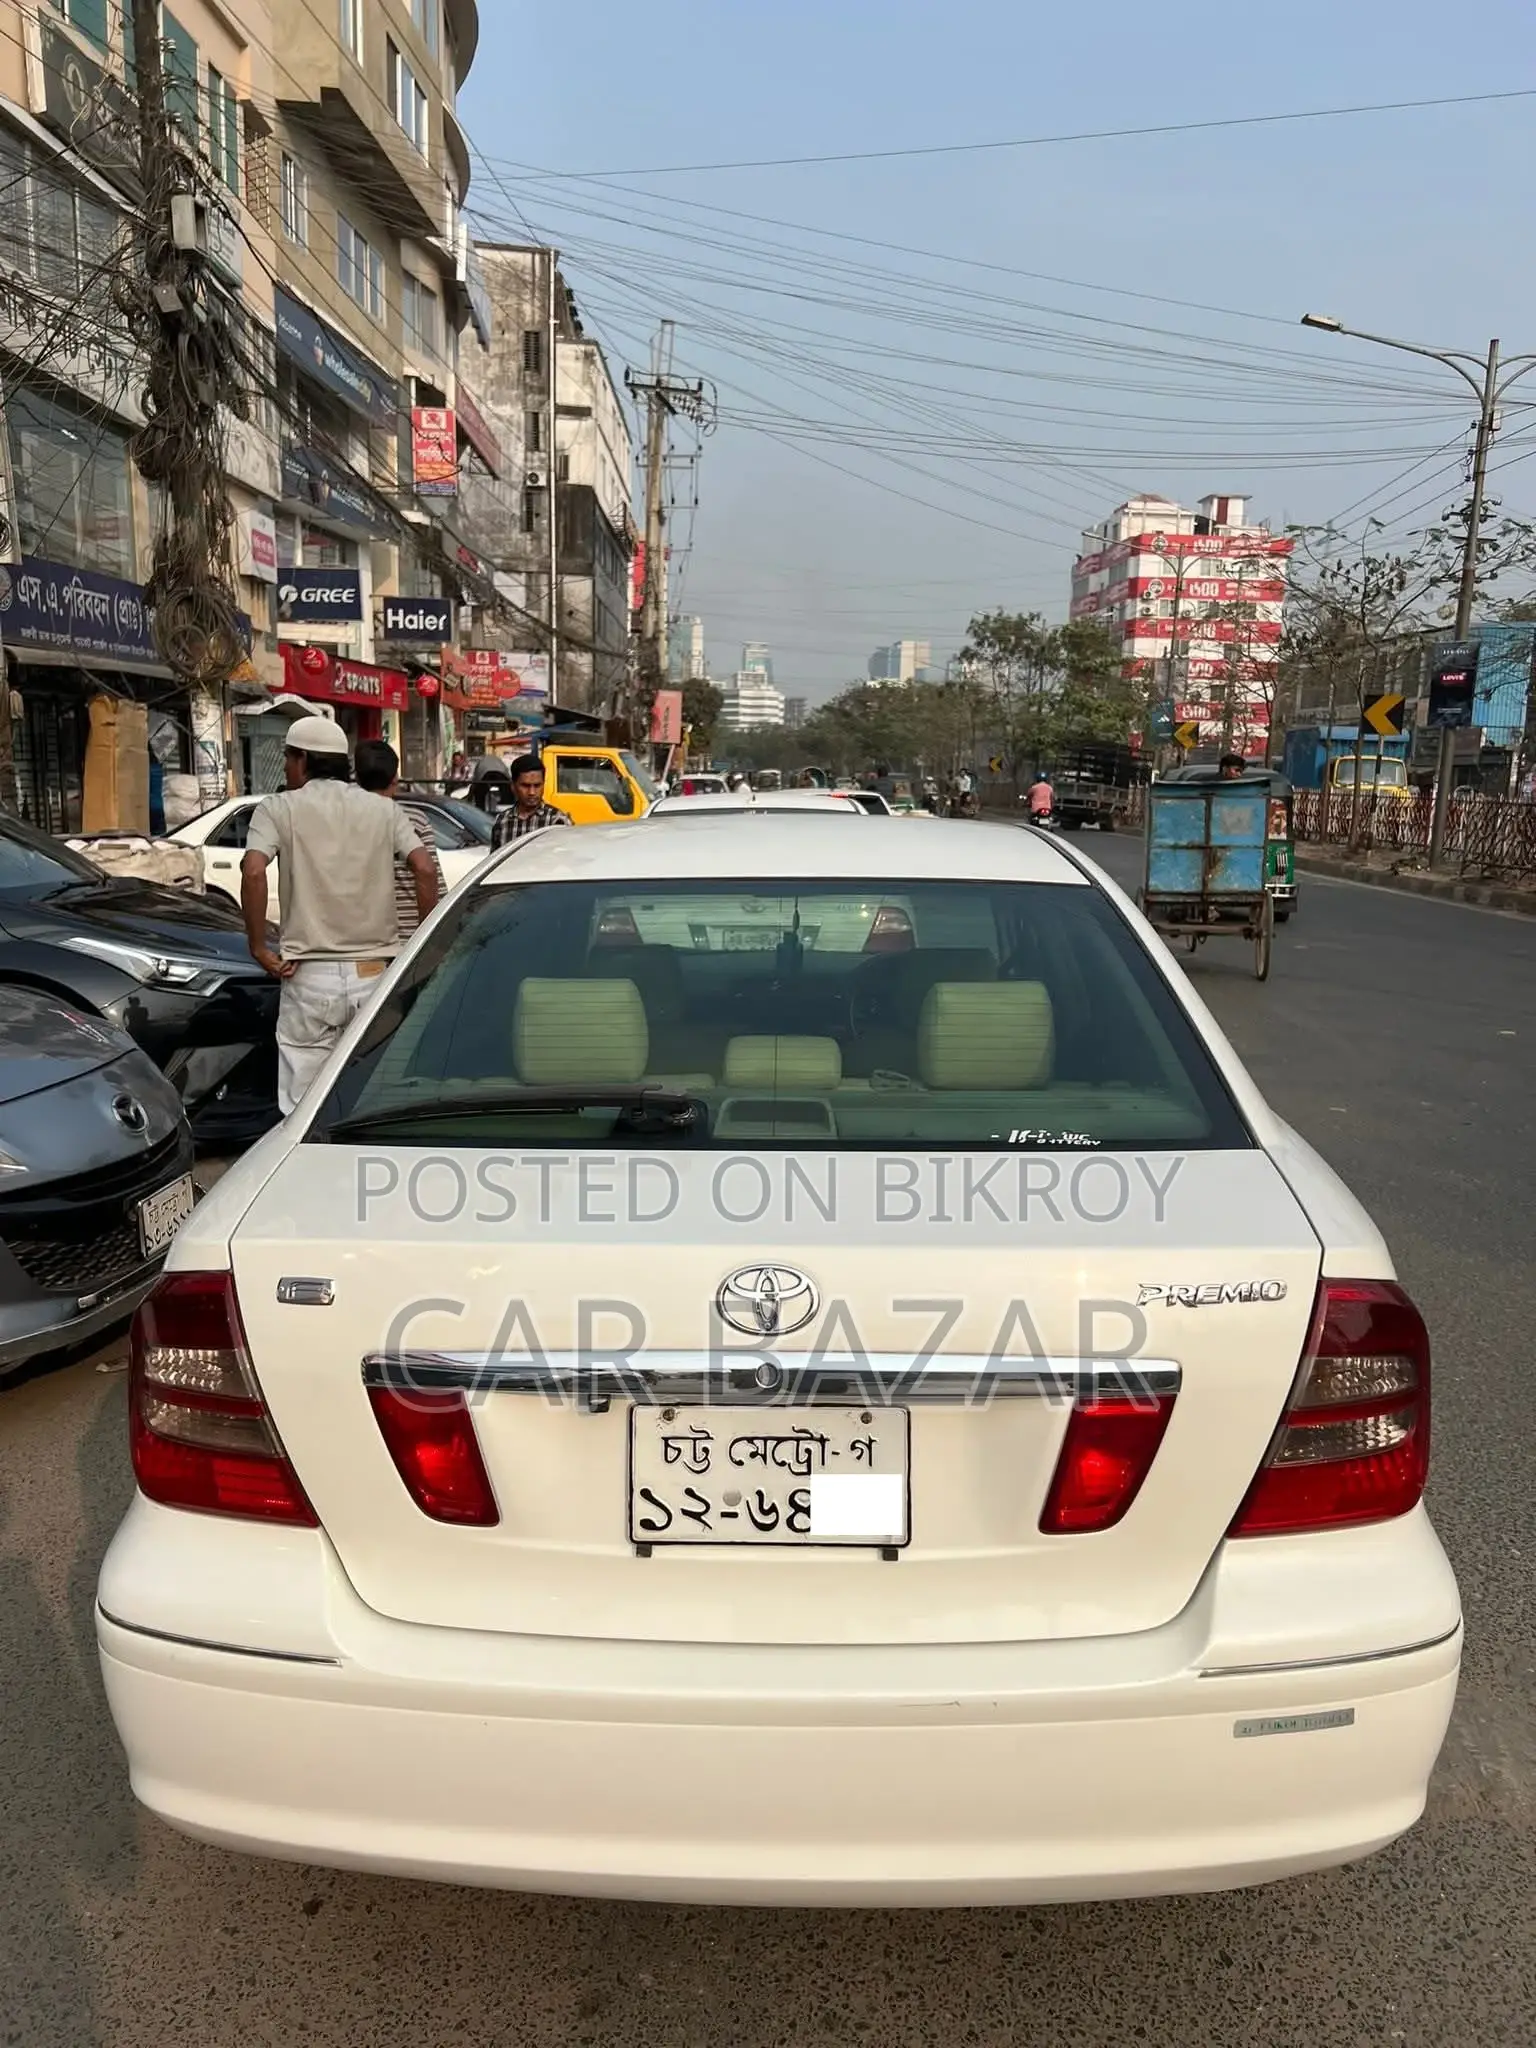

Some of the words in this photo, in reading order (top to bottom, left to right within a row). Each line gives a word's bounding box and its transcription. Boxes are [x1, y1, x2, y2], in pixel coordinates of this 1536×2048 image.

[300, 587, 356, 603] GREE
[387, 608, 447, 631] Haier
[1136, 1280, 1288, 1307] PREMIO
[661, 1425, 714, 1474] চট্ট
[639, 1487, 811, 1534] ১২-৬৪
